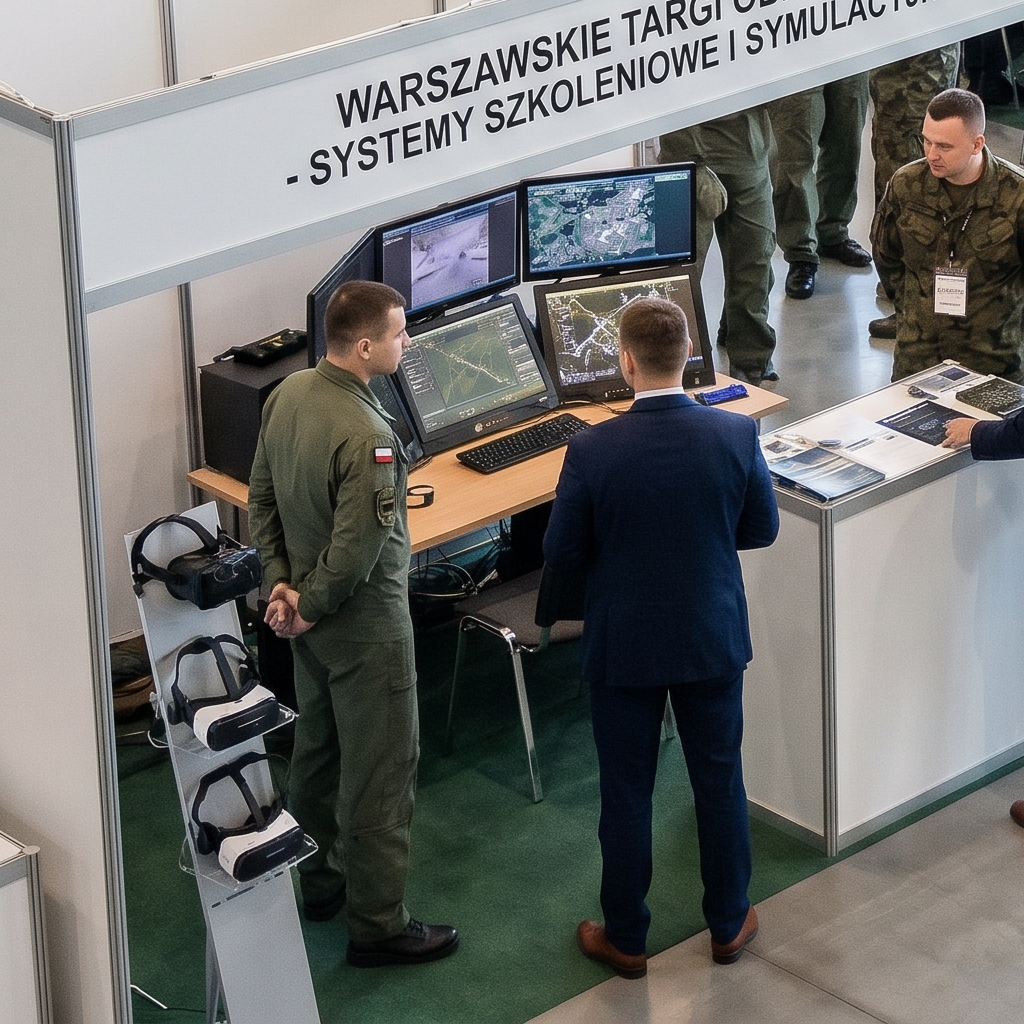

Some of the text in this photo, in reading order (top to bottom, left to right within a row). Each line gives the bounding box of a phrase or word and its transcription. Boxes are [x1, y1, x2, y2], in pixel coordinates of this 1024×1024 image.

[309, 105, 475, 186] SYSTEMY
[484, 34, 720, 134] SZKOLENIOWE
[729, 29, 736, 63] I
[335, 17, 612, 129] WARSZAWSKIE
